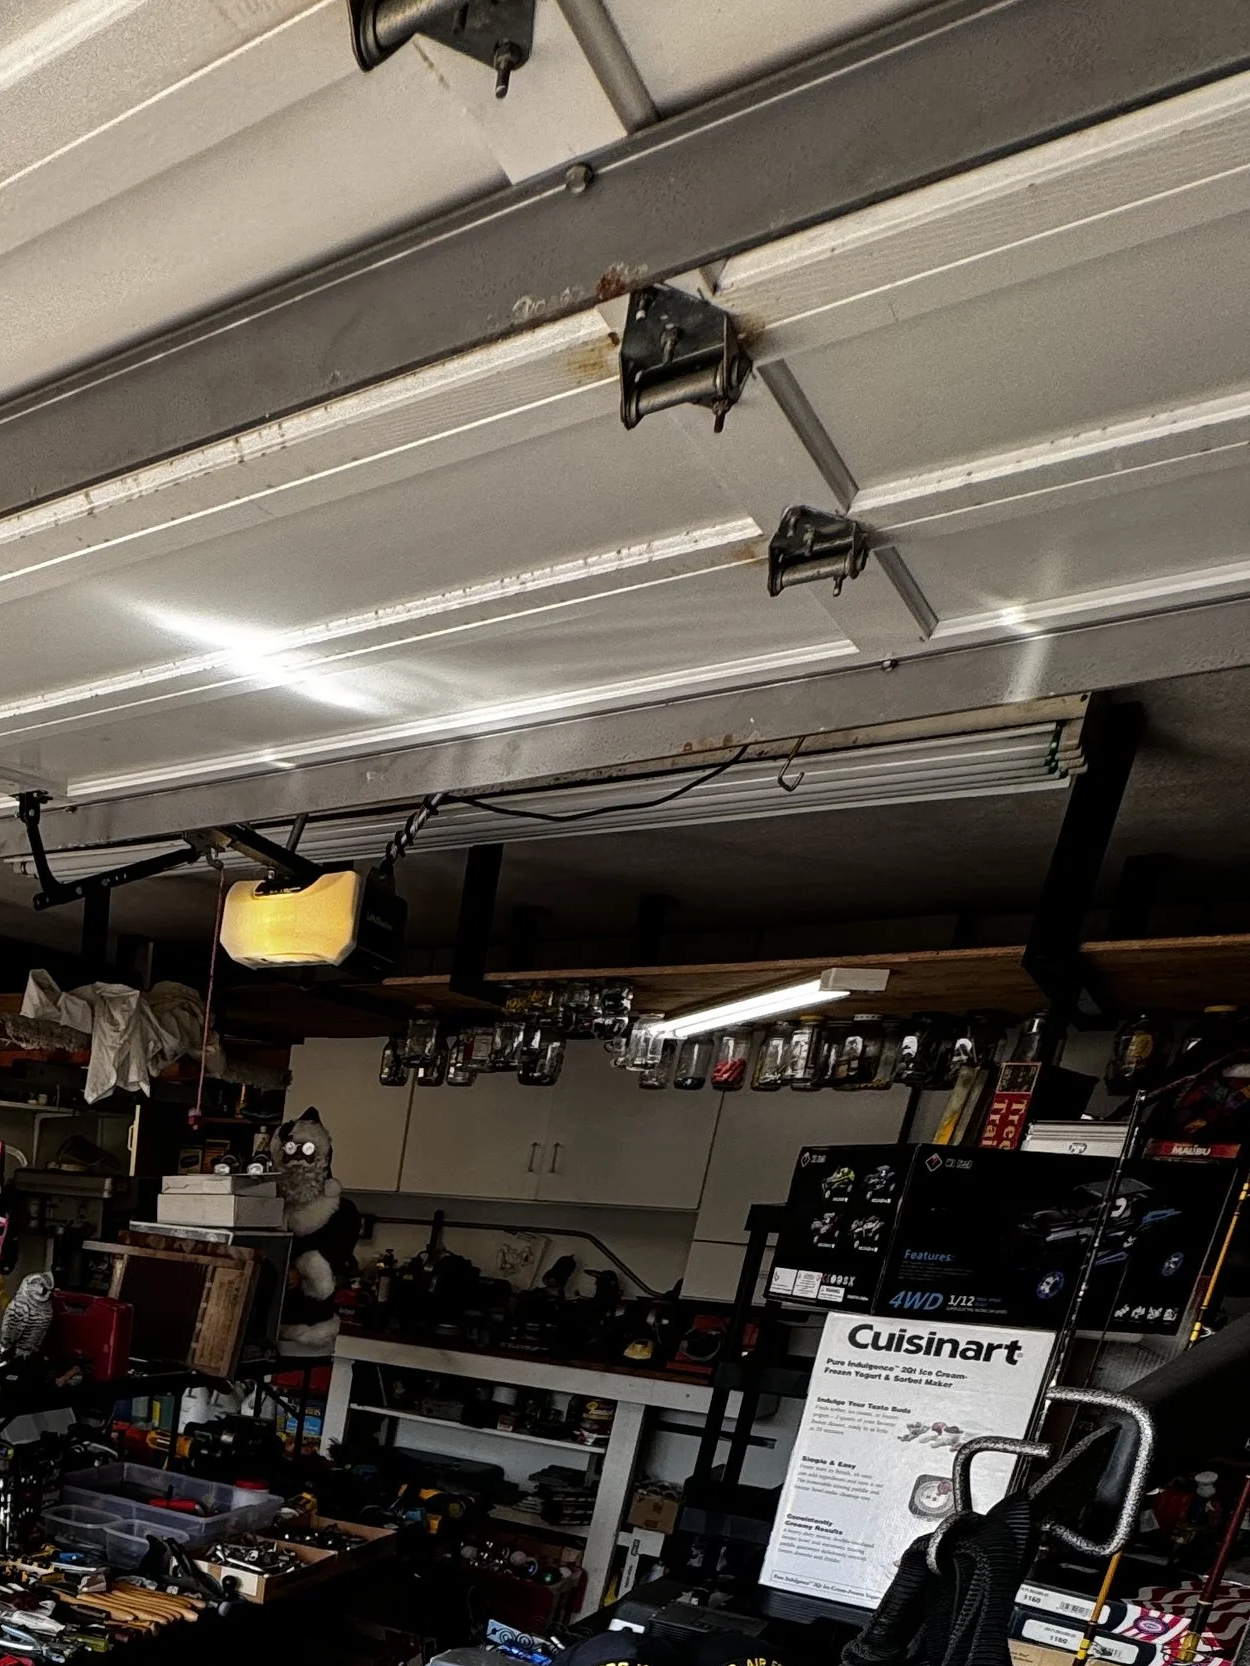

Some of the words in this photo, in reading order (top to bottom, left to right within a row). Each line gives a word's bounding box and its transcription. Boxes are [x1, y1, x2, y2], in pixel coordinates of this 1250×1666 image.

[1170, 1144, 1211, 1156] MALIBU
[887, 1289, 945, 1312] 4WD
[947, 1294, 976, 1308] 1/12
[847, 1323, 1022, 1366] Cuisinart
[826, 1357, 845, 1367] Pure
[919, 1368, 934, 1377] Ice
[823, 1367, 853, 1377] Frozen
[854, 1371, 882, 1381] Yogurt
[883, 1374, 890, 1382] &
[893, 1374, 923, 1385] Sorbet
[924, 1378, 954, 1389] Maker
[817, 1396, 846, 1407] Indulge
[848, 1400, 866, 1409] Your
[867, 1402, 889, 1412] Taste
[801, 1455, 828, 1465] Simple
[837, 1460, 857, 1470] Easy
[784, 1520, 813, 1531] Creamy
[814, 1525, 844, 1535] Results
